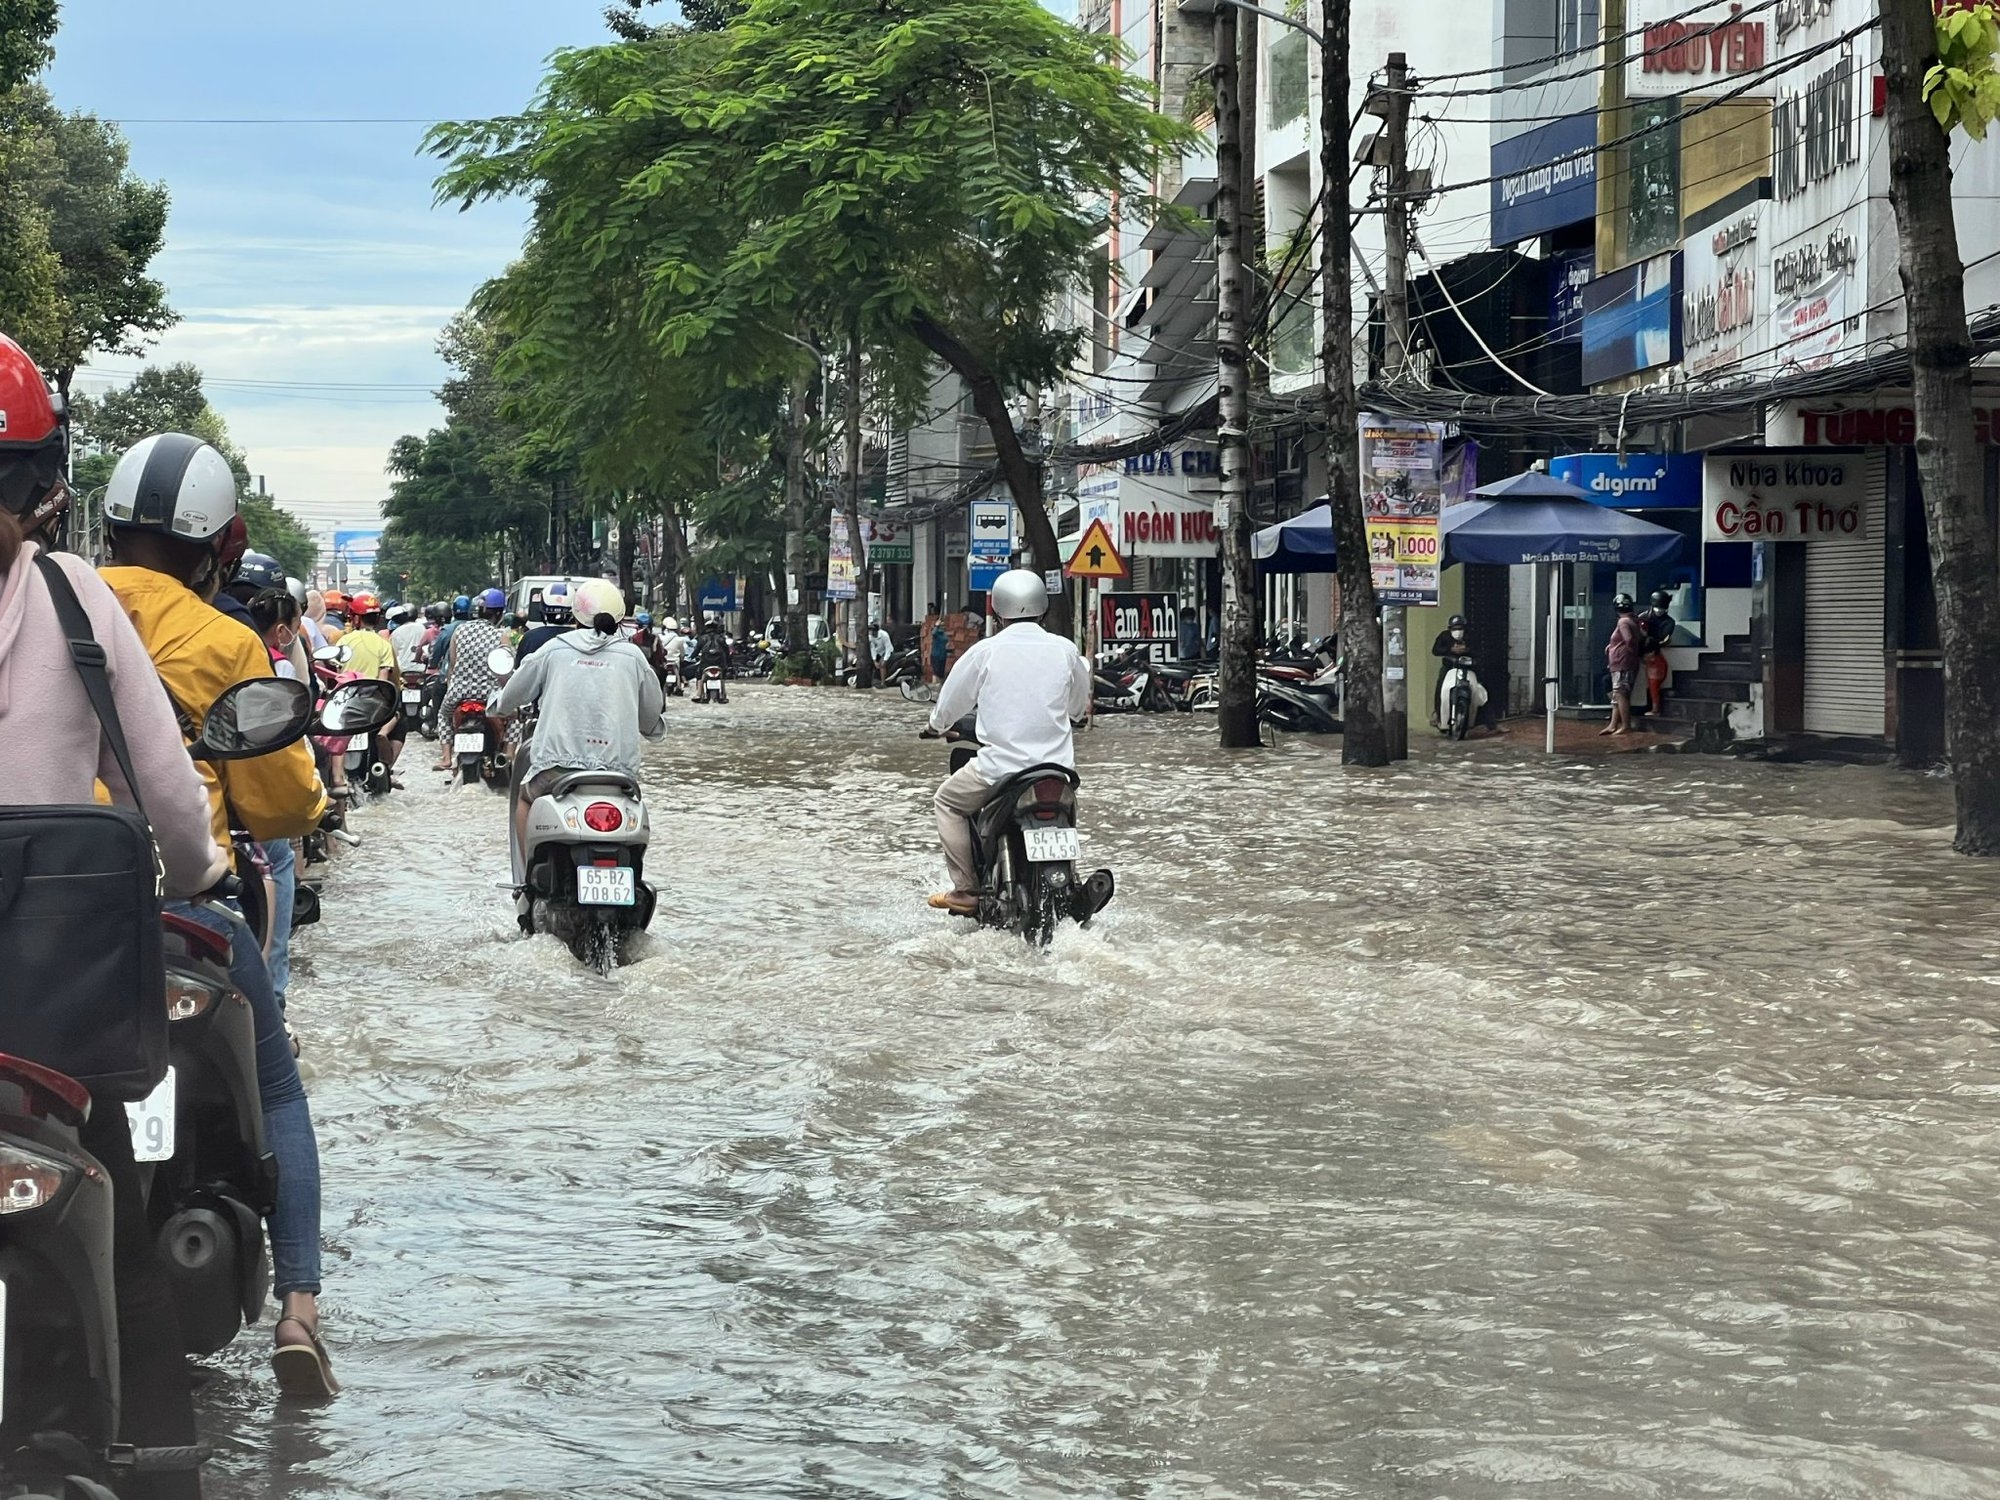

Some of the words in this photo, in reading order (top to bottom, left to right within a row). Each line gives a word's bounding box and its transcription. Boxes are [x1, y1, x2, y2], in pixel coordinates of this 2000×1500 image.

[1730, 461, 1777, 486] Nha
[1716, 494, 1784, 534] Cần
[1794, 501, 1859, 534] Thơ
[586, 870, 625, 885] 65-B2
